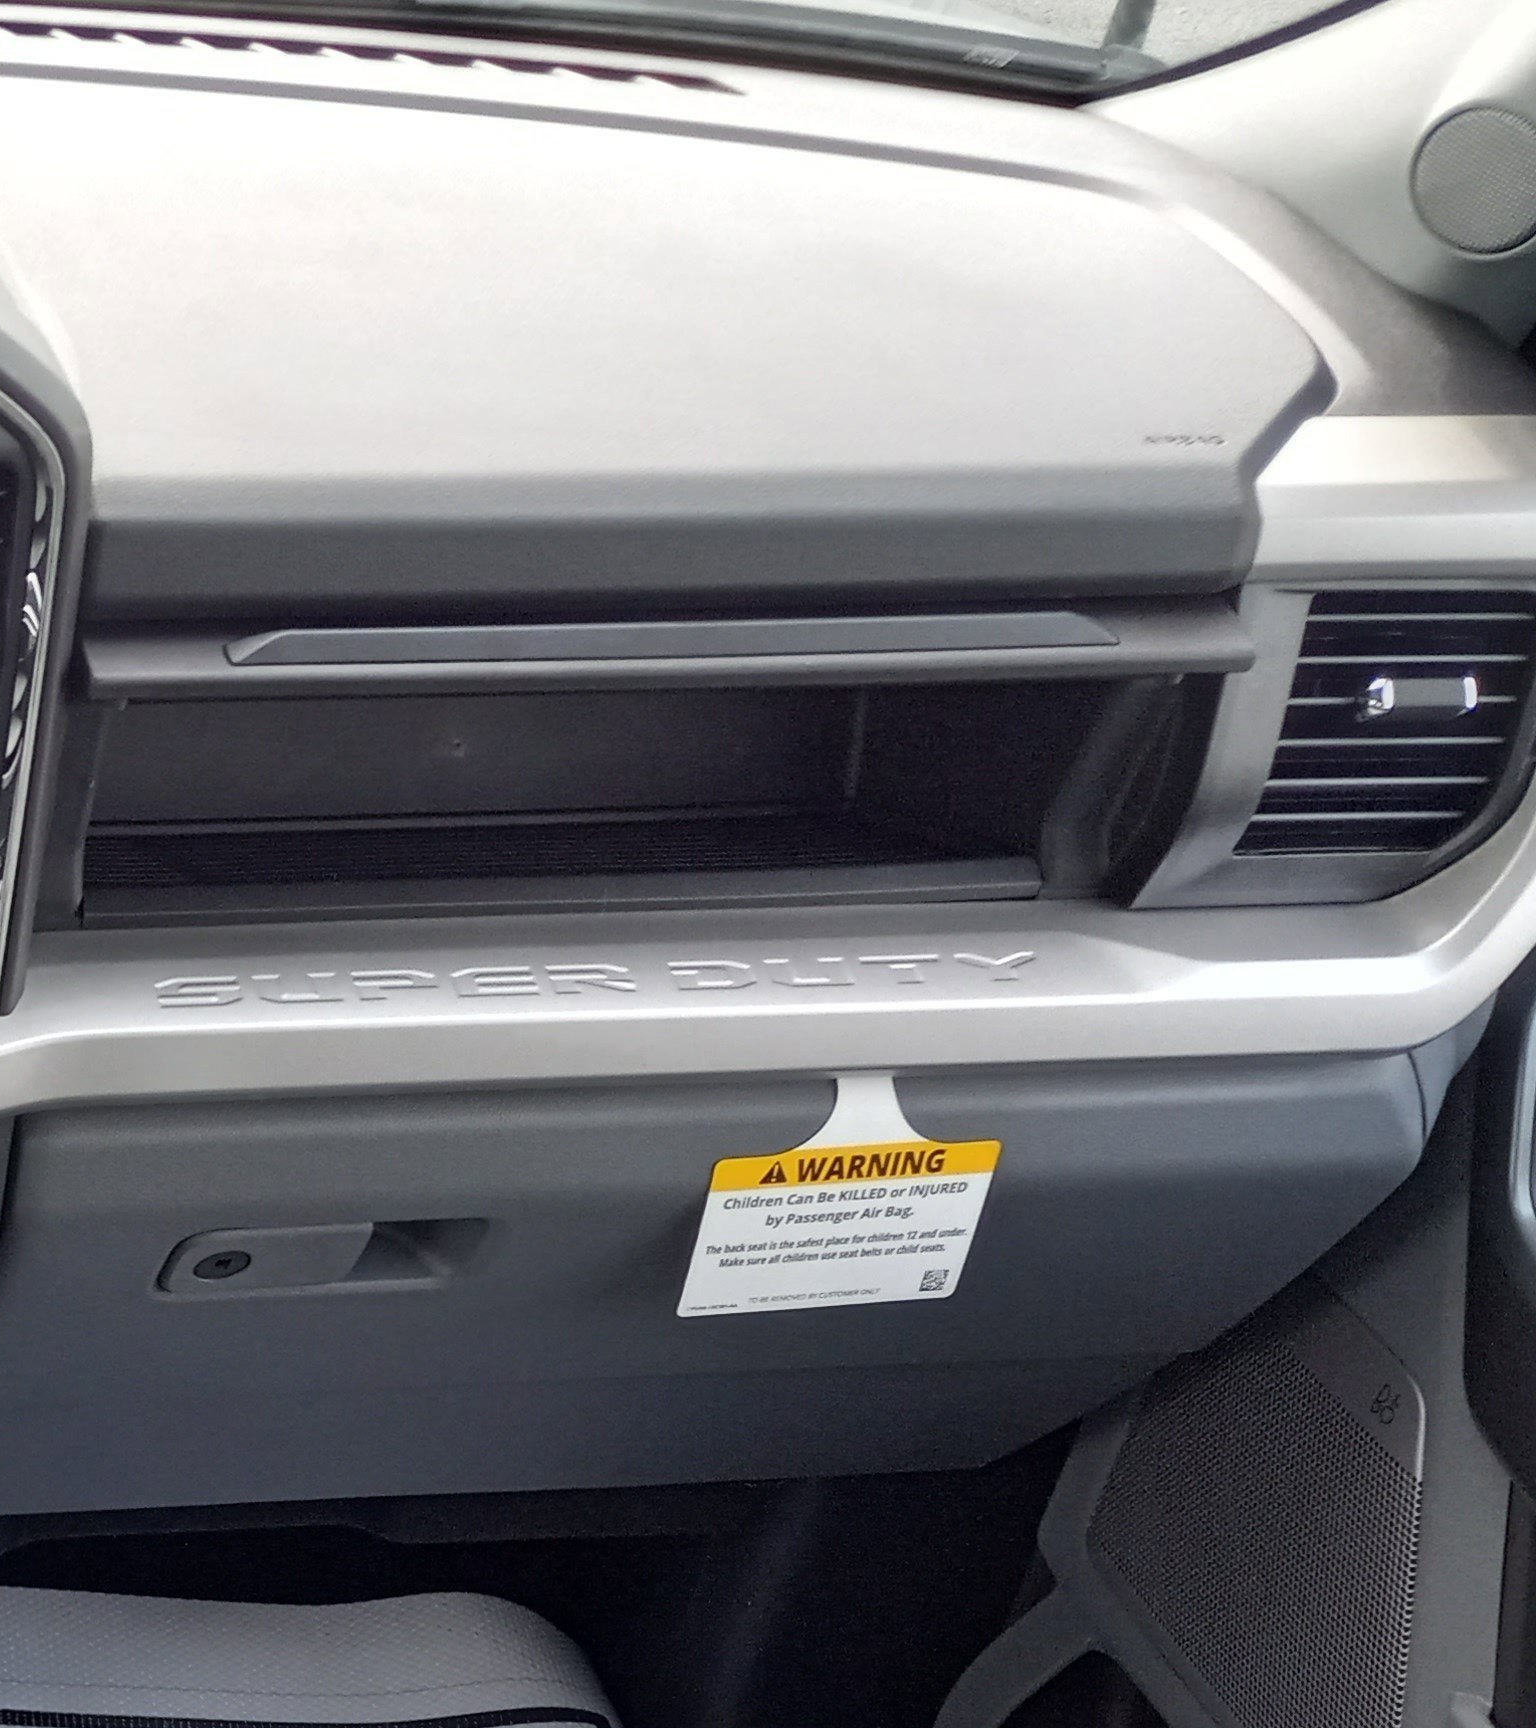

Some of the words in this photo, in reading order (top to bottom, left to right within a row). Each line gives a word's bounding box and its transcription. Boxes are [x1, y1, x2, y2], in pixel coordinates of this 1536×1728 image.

[154, 962, 638, 1008] SUPER
[666, 951, 1036, 991] DUTY
[797, 1149, 947, 1182] WARNING
[723, 1196, 783, 1210] Children
[786, 1193, 813, 1206] Can
[817, 1191, 836, 1203] Be
[838, 1188, 887, 1202] KILLED
[890, 1188, 907, 1198] or
[908, 1181, 968, 1199] INJURED
[765, 1214, 783, 1229] by
[785, 1210, 859, 1225] Passenger
[860, 1207, 883, 1220] Air
[884, 1205, 915, 1220] Bag.
[706, 1245, 723, 1255] The
[723, 1243, 746, 1254] back
[747, 1242, 767, 1253] seat
[769, 1241, 777, 1250] is
[778, 1240, 794, 1250] the
[796, 1237, 824, 1249] safest
[824, 1236, 850, 1248] place
[851, 1234, 866, 1245] for
[867, 1232, 905, 1243] children
[918, 1228, 937, 1239] and
[718, 1258, 745, 1268] Make
[746, 1257, 767, 1266] sure
[782, 1252, 819, 1263] children
[820, 1252, 837, 1261] use
[838, 1249, 859, 1259] seat
[860, 1247, 883, 1258] belts
[884, 1248, 895, 1256] or
[896, 1245, 919, 1255] child
